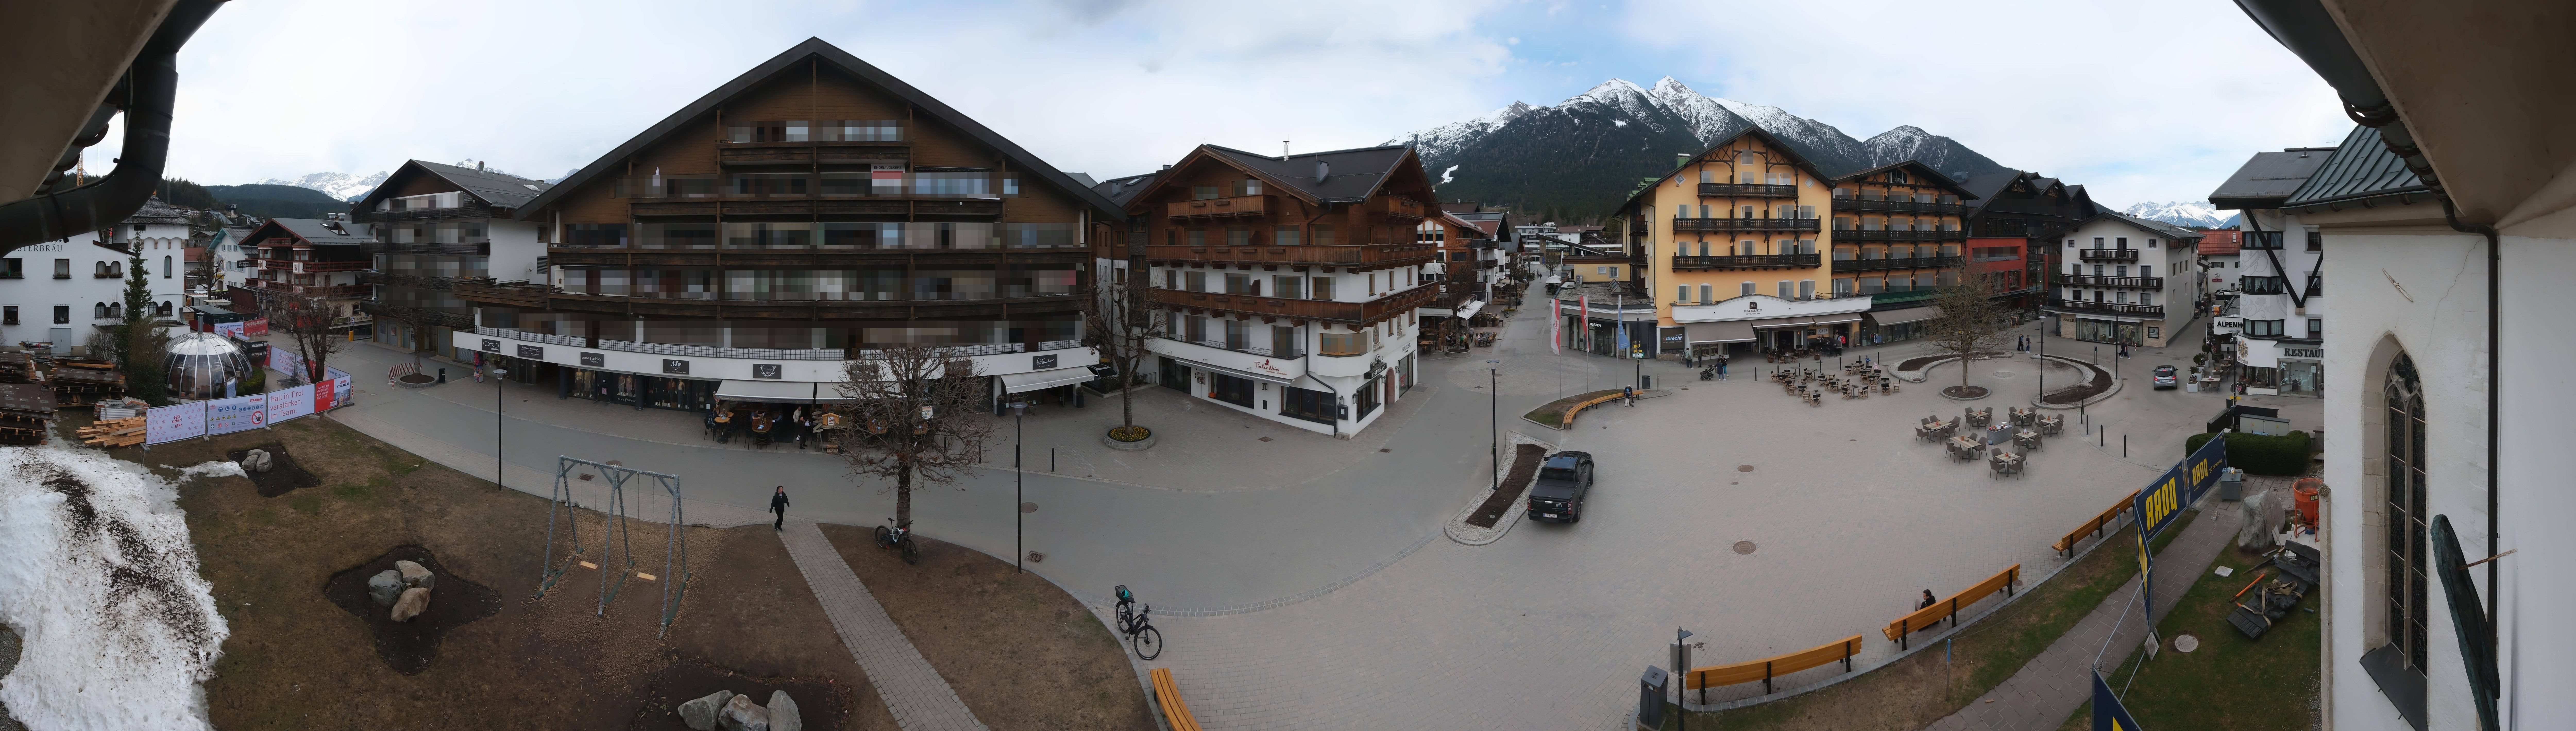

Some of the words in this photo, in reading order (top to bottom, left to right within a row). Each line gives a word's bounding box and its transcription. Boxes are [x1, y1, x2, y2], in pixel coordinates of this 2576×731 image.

[1372, 364, 1386, 377] RESTAURANT
[271, 394, 282, 402] Hall
[291, 389, 303, 398] Tirol
[270, 400, 302, 411] verstärken.
